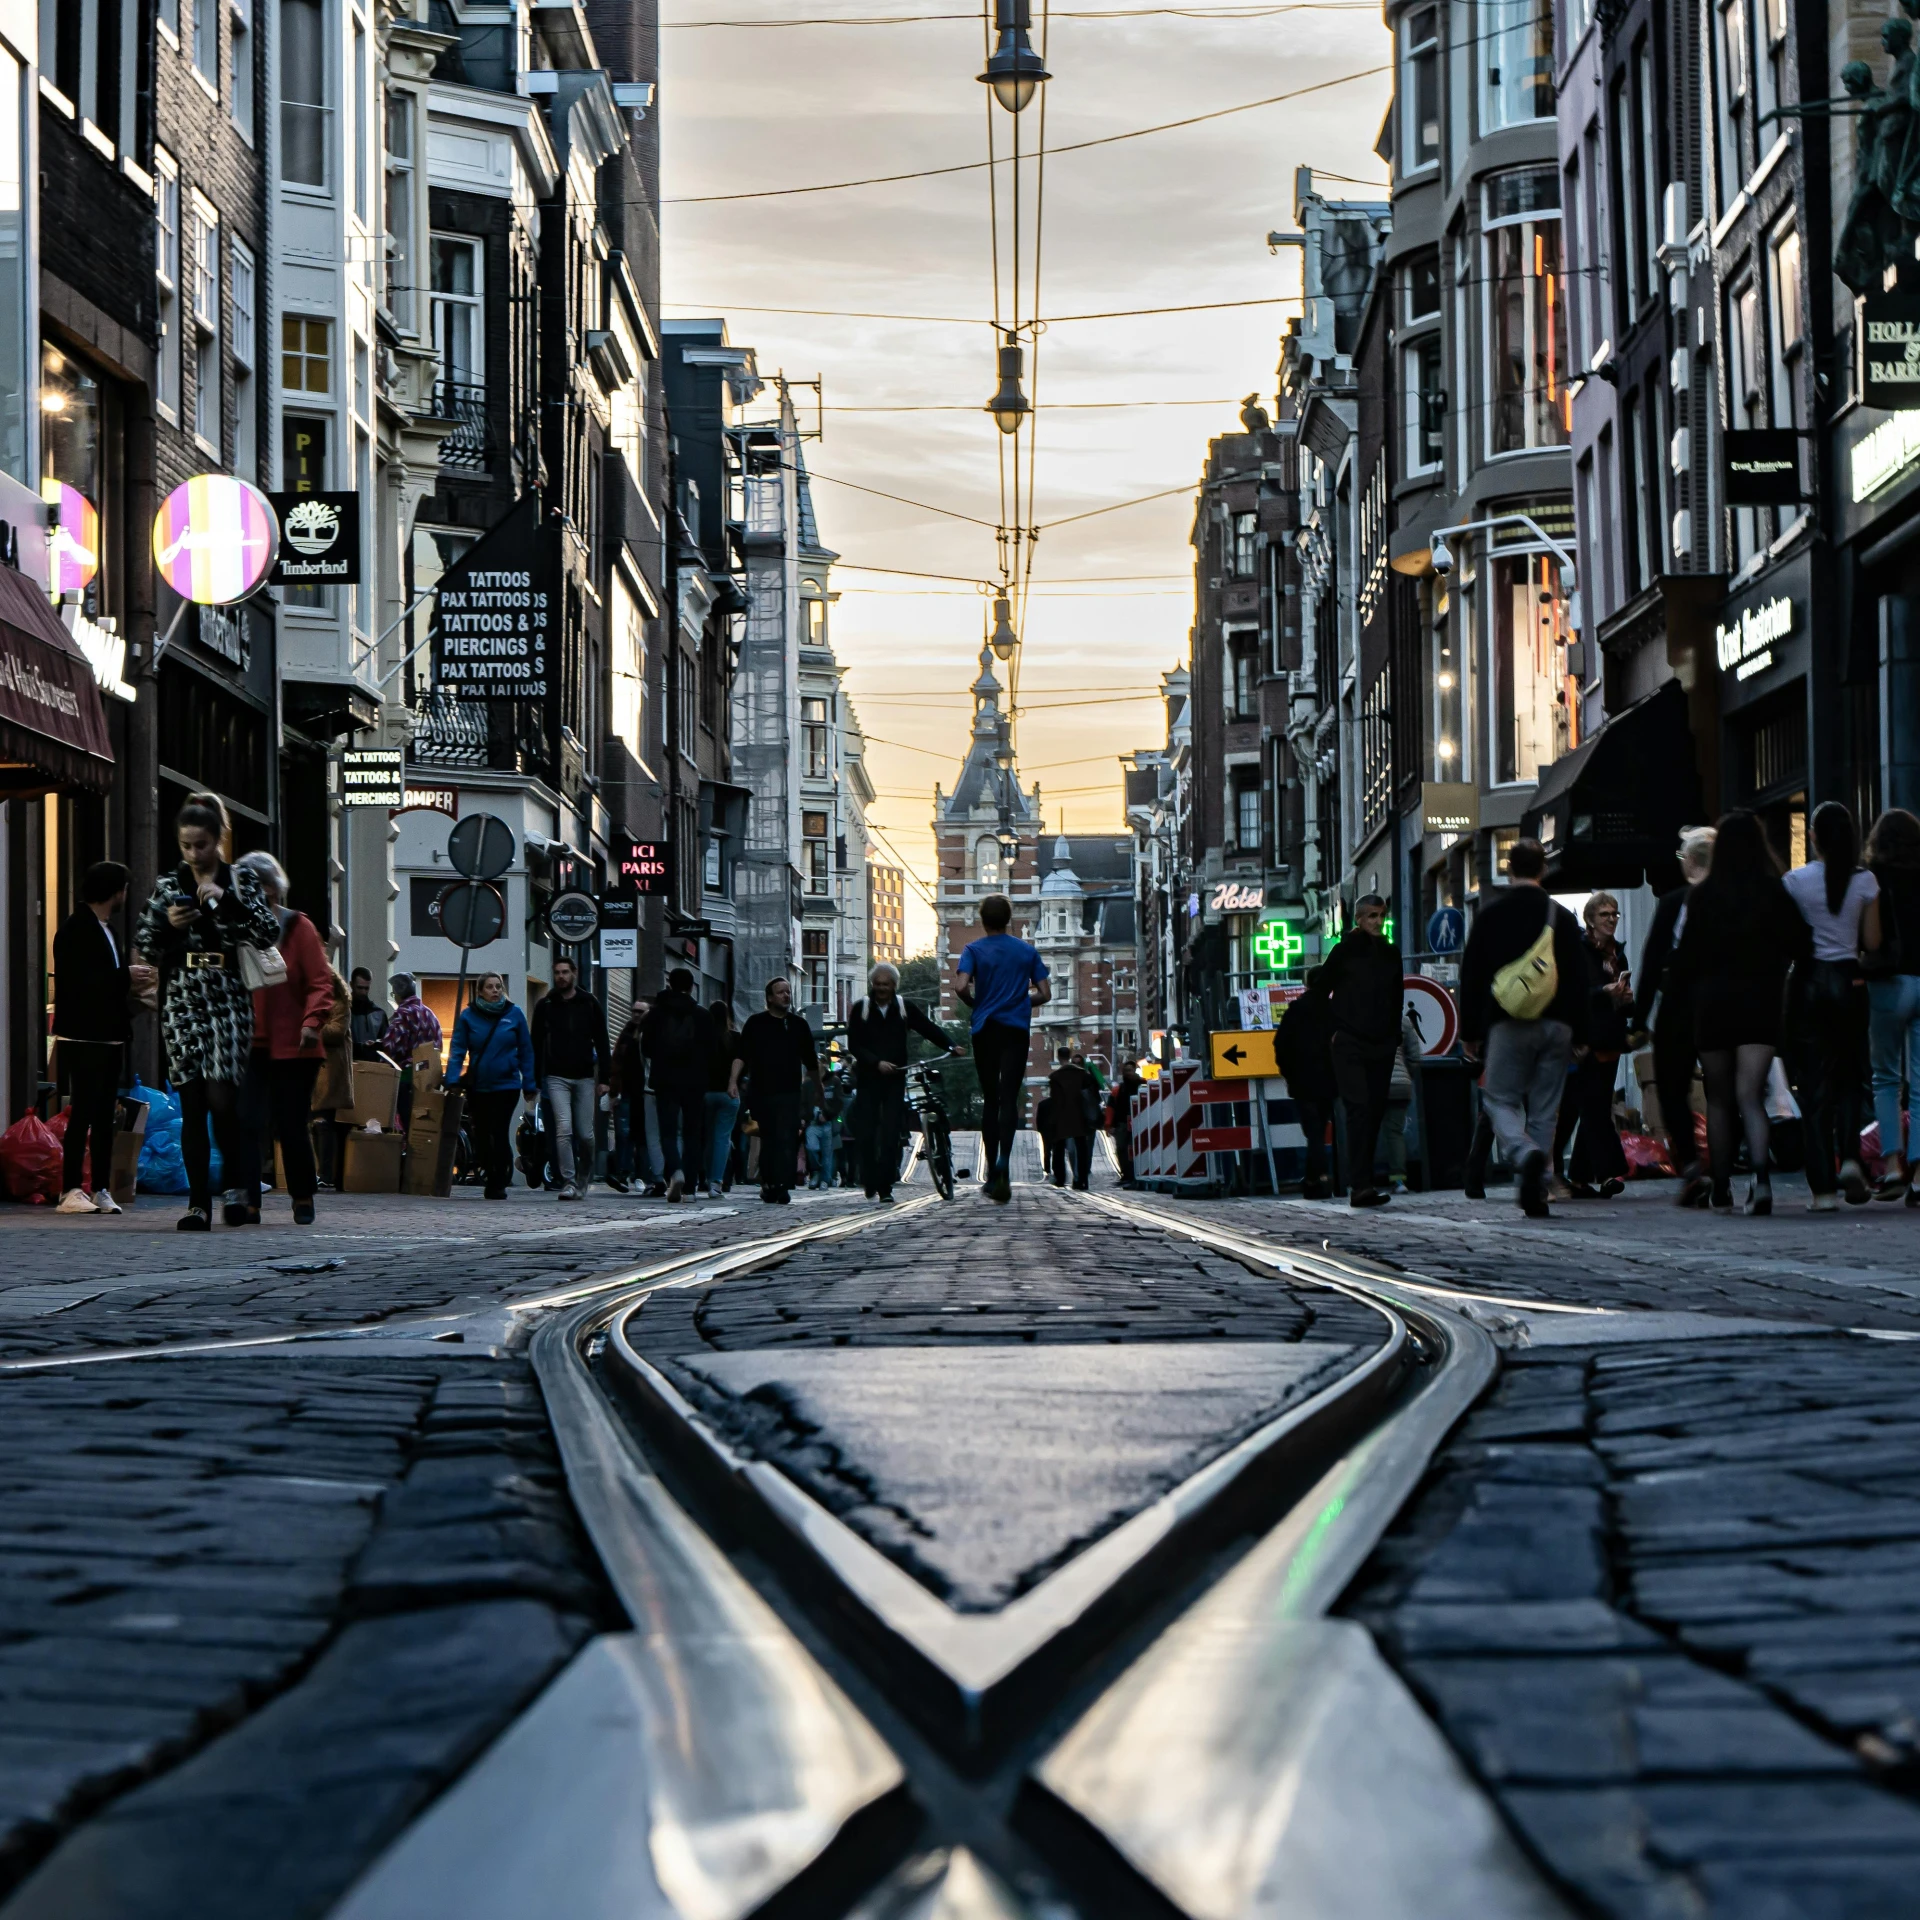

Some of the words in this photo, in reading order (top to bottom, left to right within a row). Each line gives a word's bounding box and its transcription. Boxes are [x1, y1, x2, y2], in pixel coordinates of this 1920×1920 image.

[1868, 321, 1920, 342] HOLL
[1870, 361, 1920, 382] BARR
[279, 559, 348, 575] Timberland
[468, 571, 531, 588] TATTOOS
[441, 592, 467, 607] PAX
[470, 592, 531, 607] TATTOOS
[442, 614, 513, 632] TATTOOS
[518, 613, 529, 632] &
[444, 638, 528, 656] PIERCINGS
[441, 663, 467, 678] PAX
[470, 663, 531, 678] TATTOOS
[344, 752, 362, 762] PAX
[362, 752, 401, 762] TATTOOS
[344, 771, 391, 784] TATTOOS
[392, 771, 401, 783] &
[345, 792, 400, 805] PIERCINGS
[402, 789, 454, 812] AMPER
[632, 845, 655, 858] ICI
[621, 861, 665, 875] PARIS
[634, 879, 652, 891] XL
[1211, 883, 1263, 910] Hotel
[603, 902, 634, 910] SINNER
[604, 939, 634, 947] SINNER
